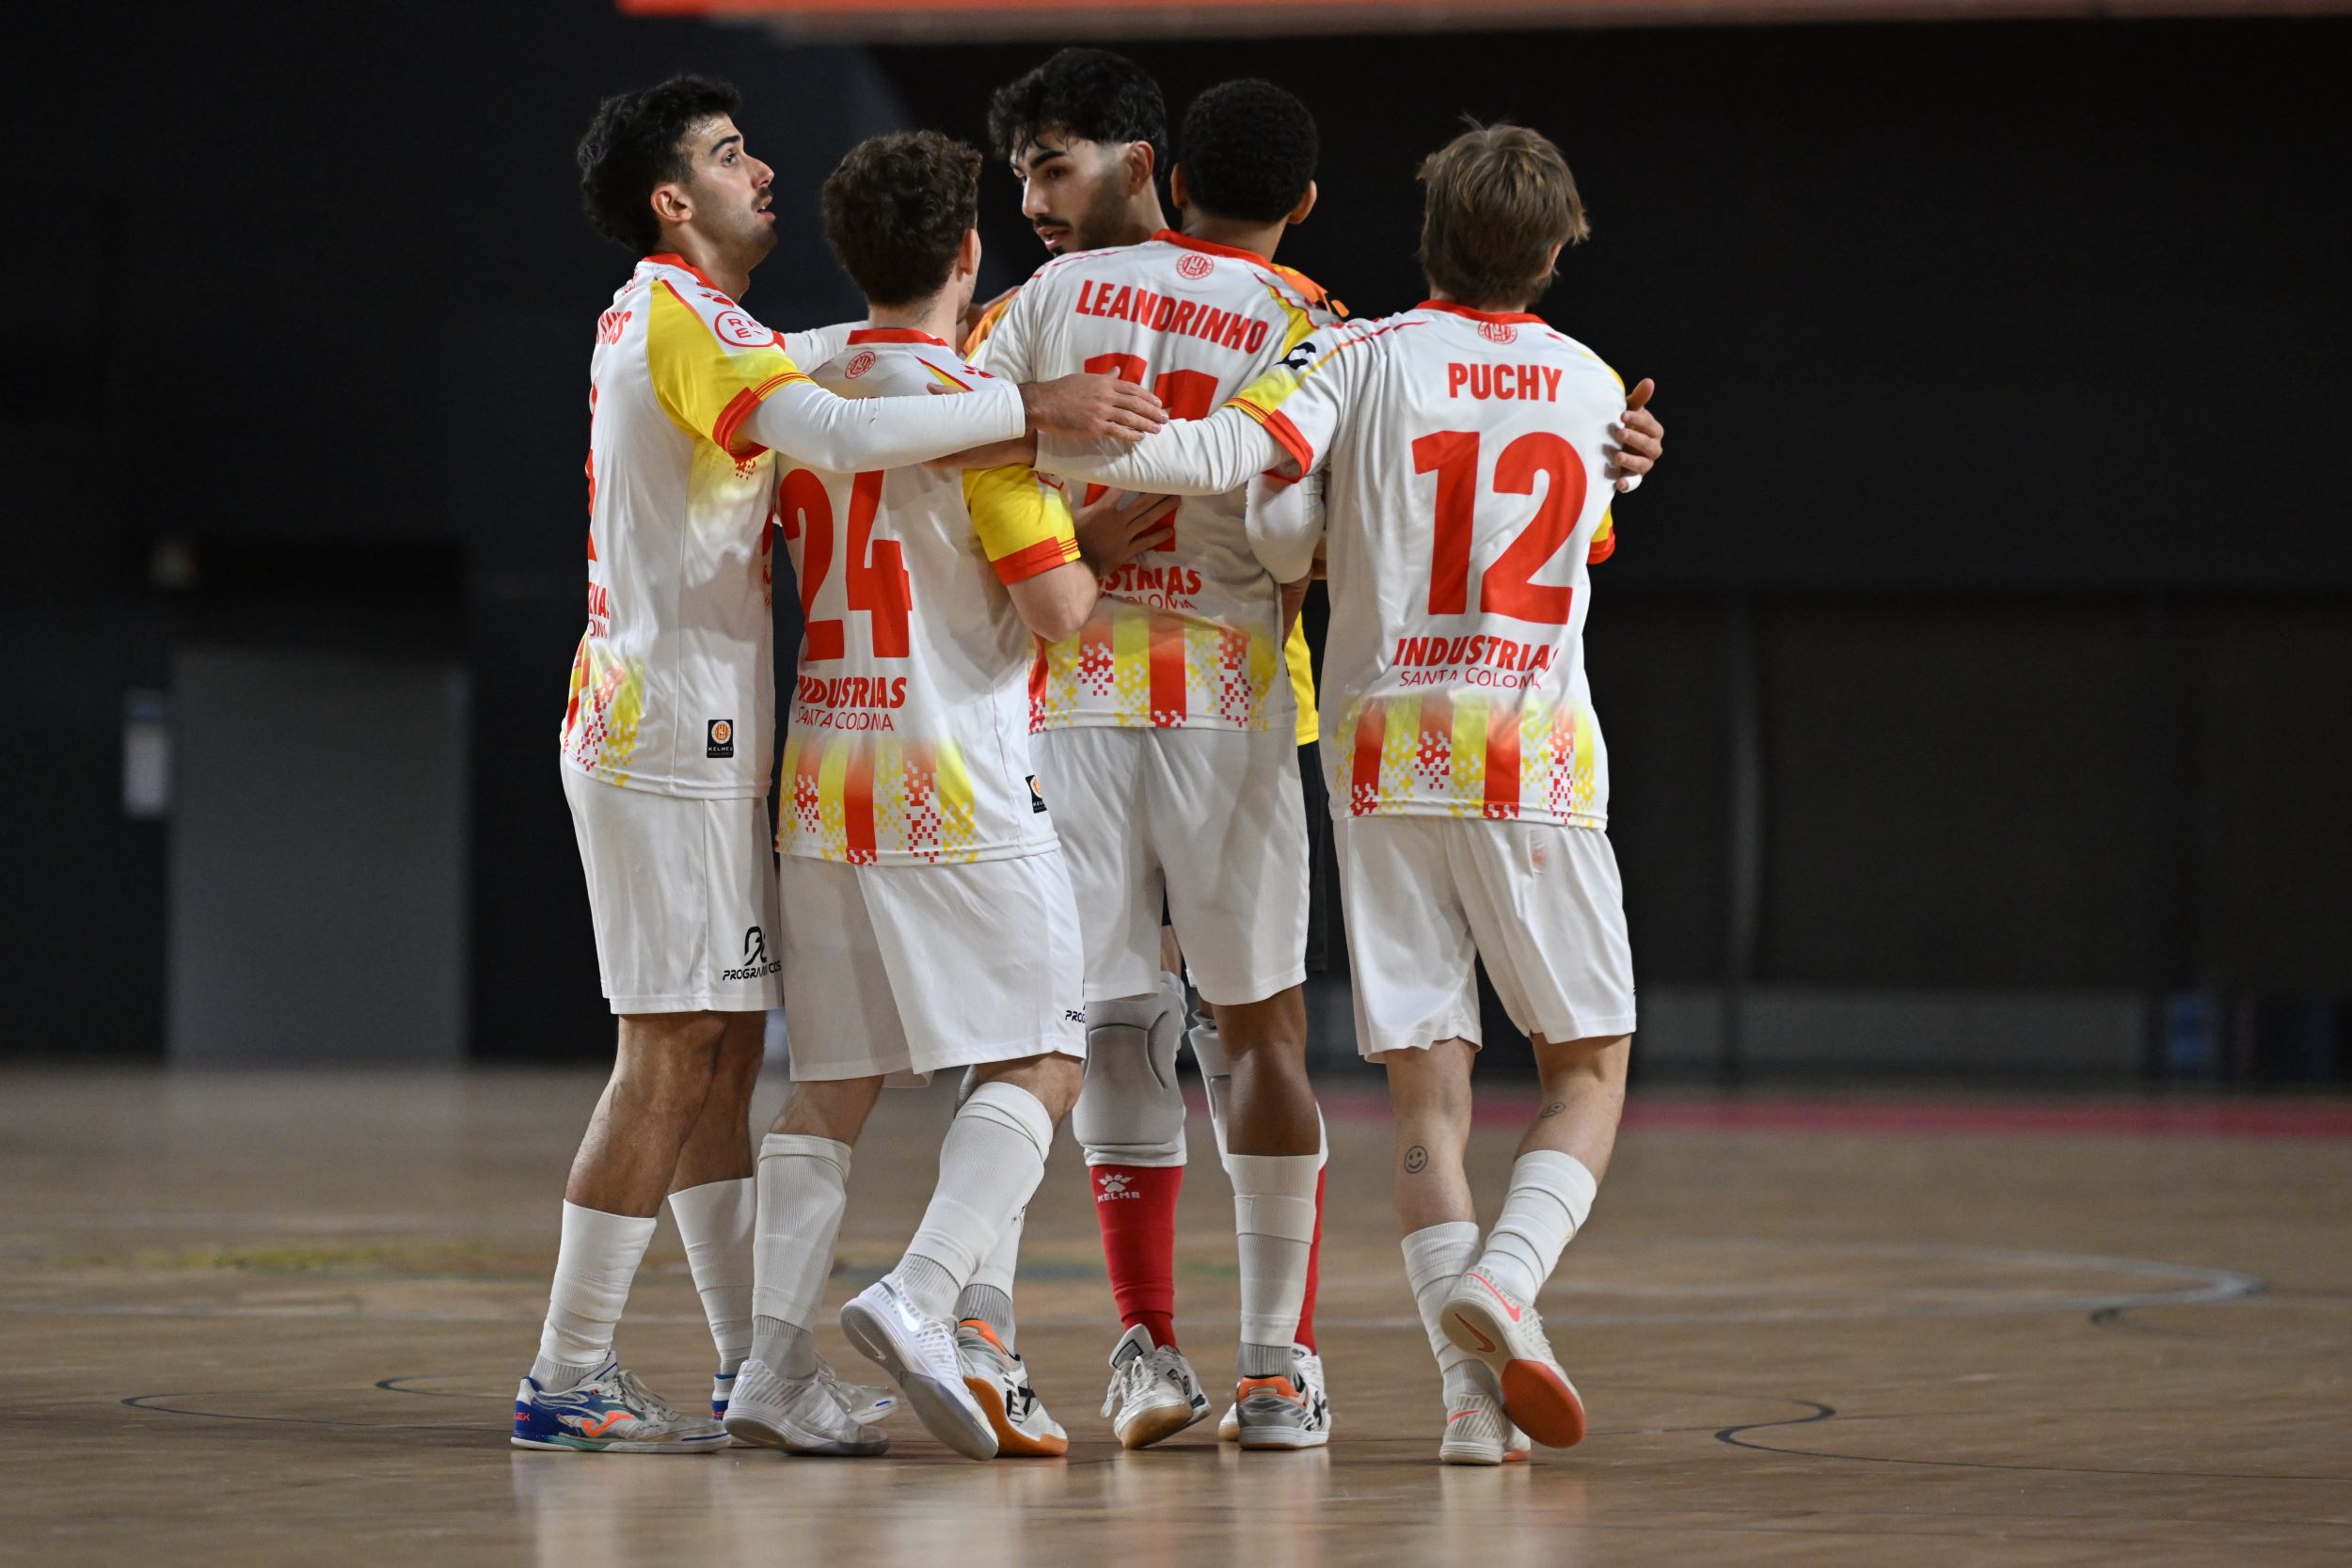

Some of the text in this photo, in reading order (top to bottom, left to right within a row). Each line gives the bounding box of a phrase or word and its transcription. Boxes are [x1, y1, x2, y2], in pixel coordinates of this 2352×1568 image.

[1075, 279, 1269, 355] LEANDRINHO
[1448, 362, 1563, 403] PUCHY
[1411, 430, 1588, 626] 12
[779, 467, 913, 662] 24
[1399, 669, 1457, 687] SANTA
[1097, 1191, 1140, 1203] KELME
